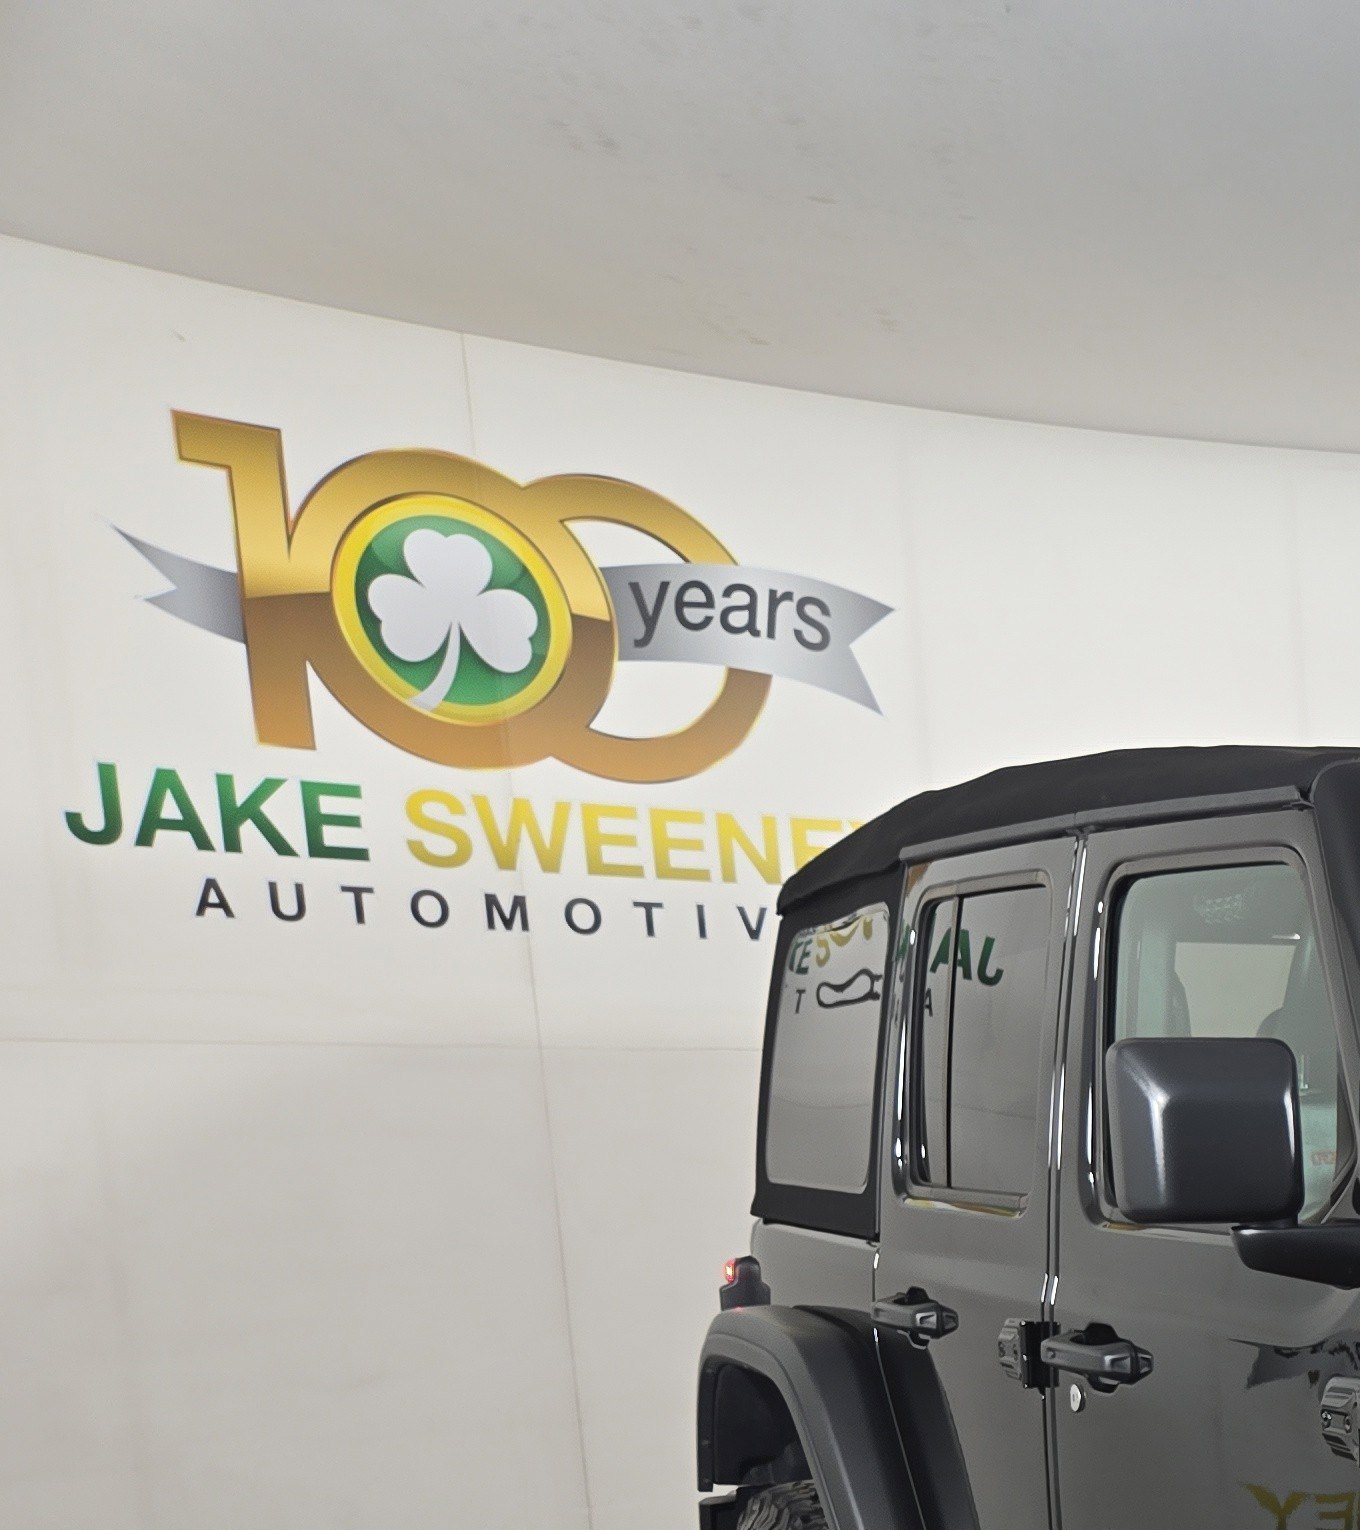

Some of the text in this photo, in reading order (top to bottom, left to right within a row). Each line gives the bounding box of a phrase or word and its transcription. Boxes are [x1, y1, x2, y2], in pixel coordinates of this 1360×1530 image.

[628, 575, 833, 653] years
[64, 762, 868, 886] JAKE SWEENE
[195, 878, 768, 941] AUTOMOTIV
